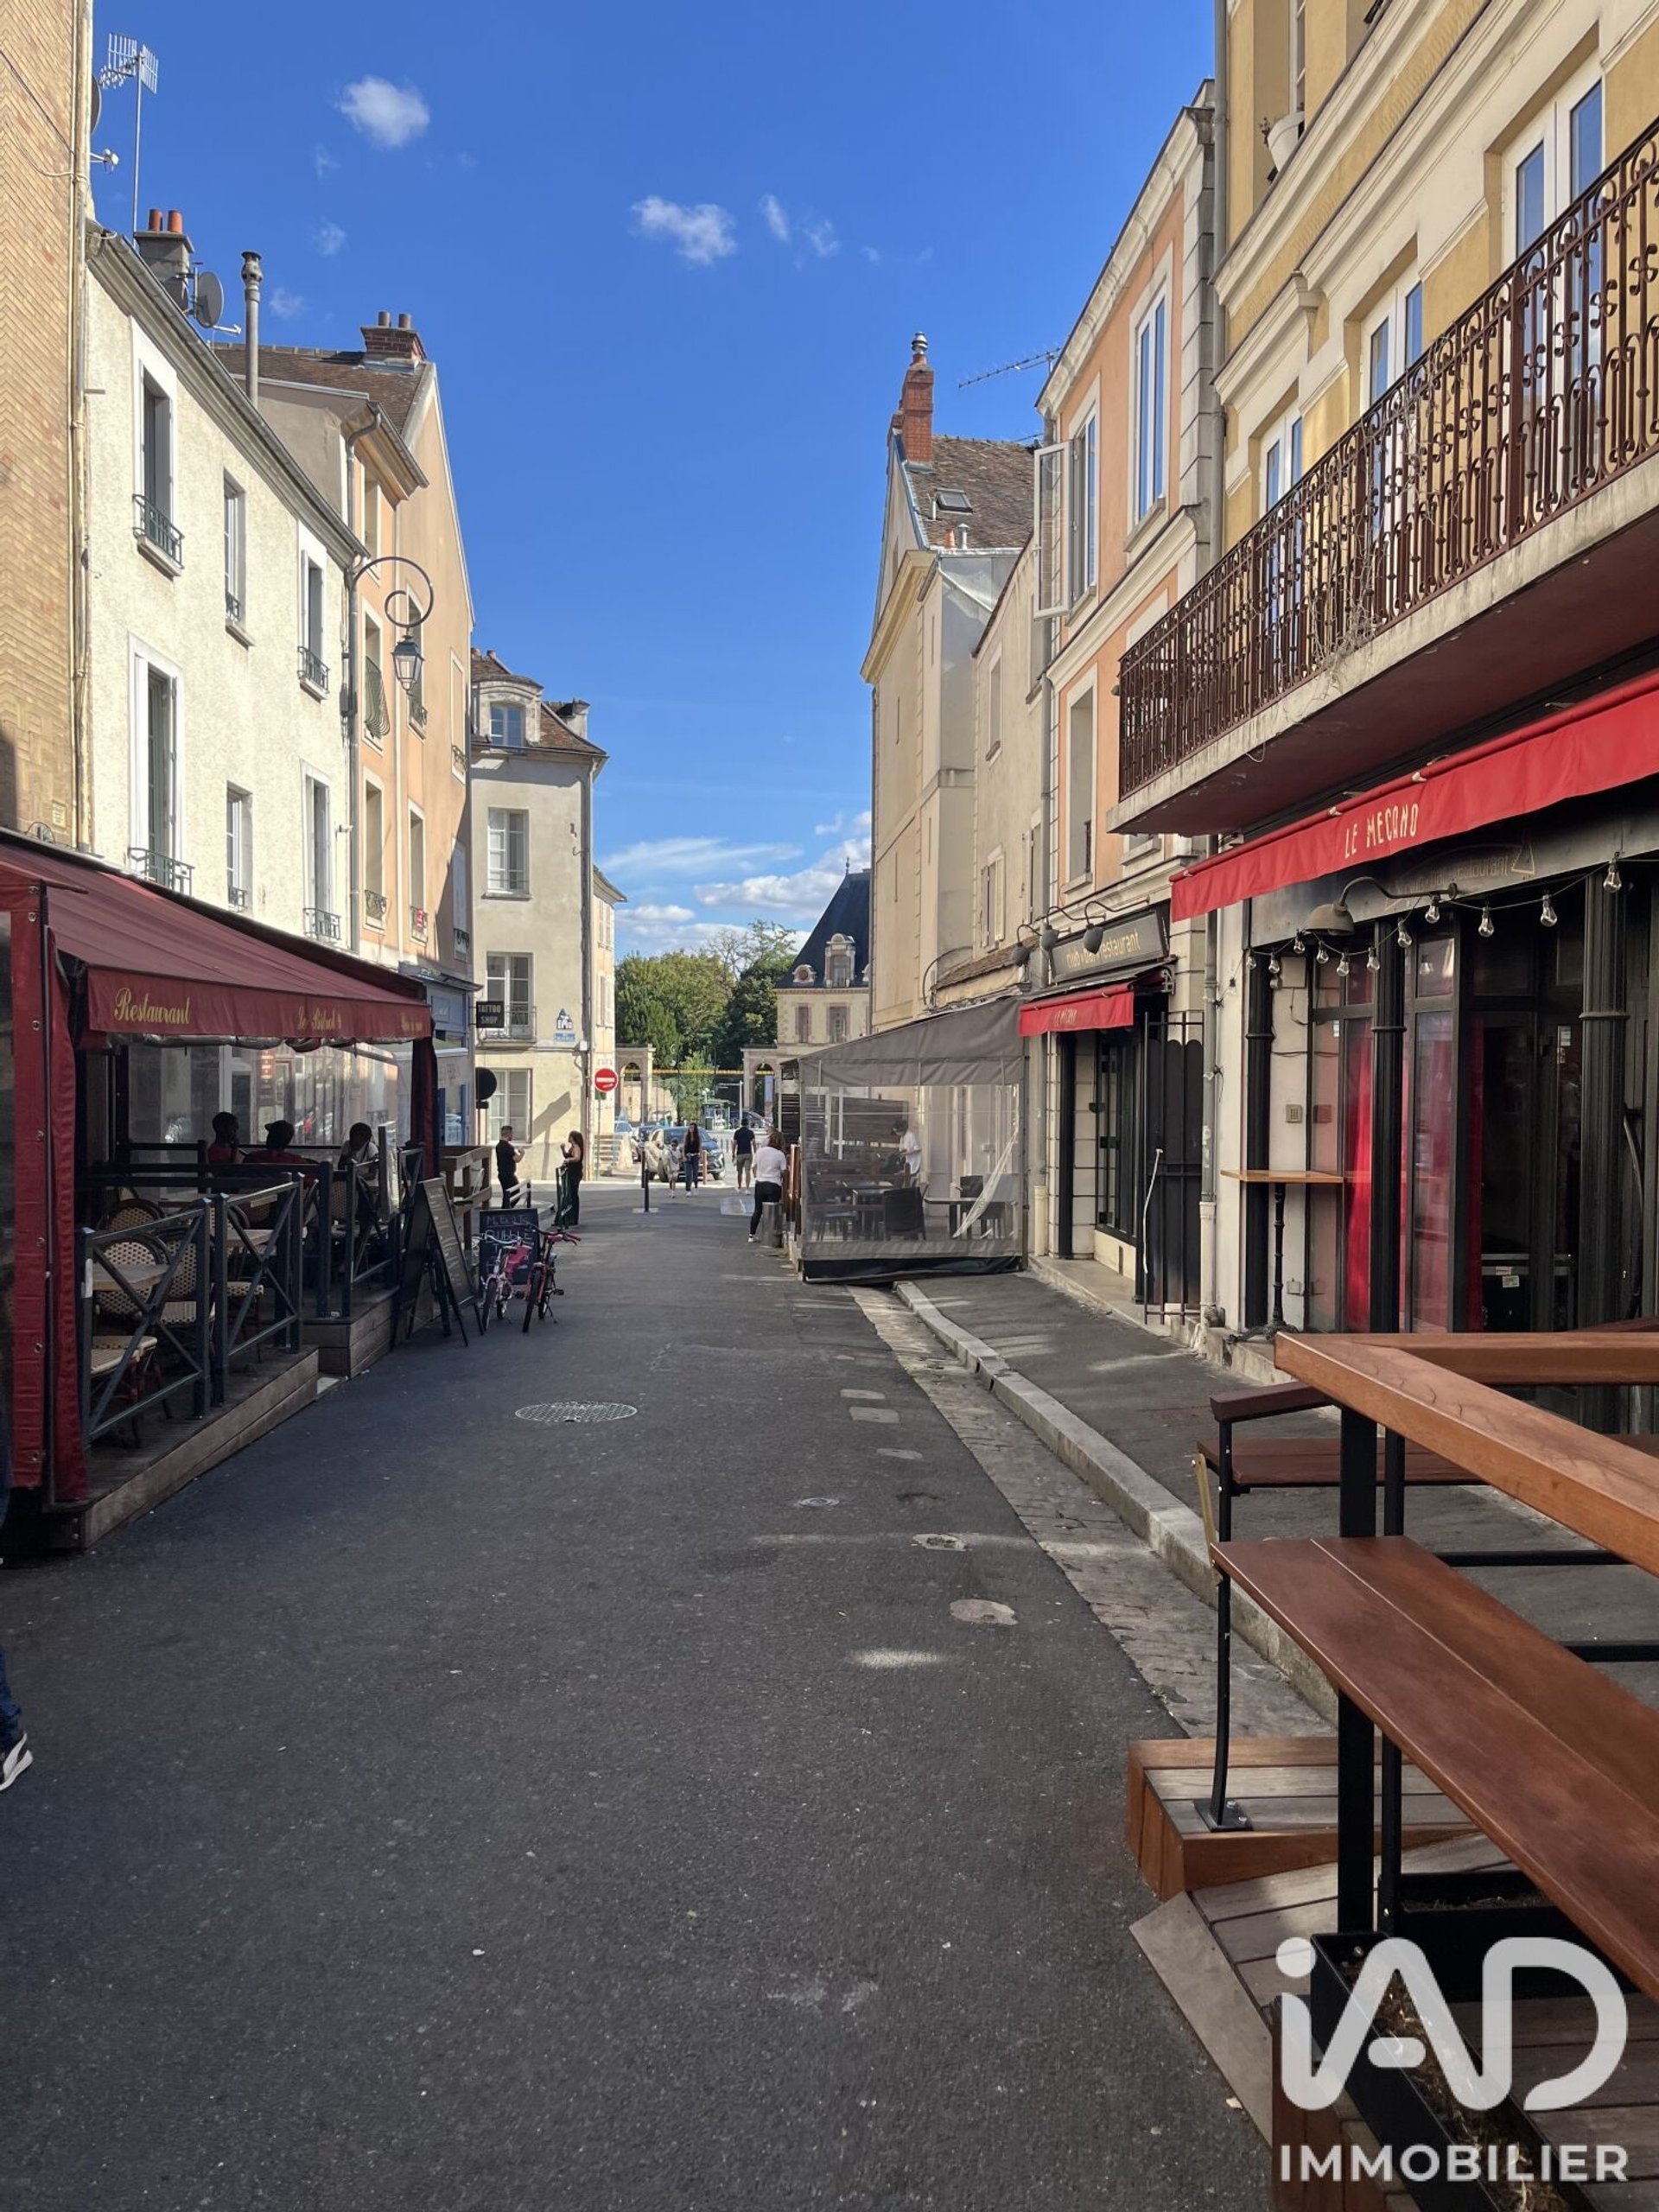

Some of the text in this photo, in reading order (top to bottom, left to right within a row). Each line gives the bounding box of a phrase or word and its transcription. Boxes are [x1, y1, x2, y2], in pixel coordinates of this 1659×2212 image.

[1344, 803, 1419, 860] LE MECANO
[1100, 929, 1141, 960] restaurant
[114, 987, 191, 1025] Restaurant
[478, 1004, 501, 1014] TATTOO
[480, 1015, 498, 1025] SHOP
